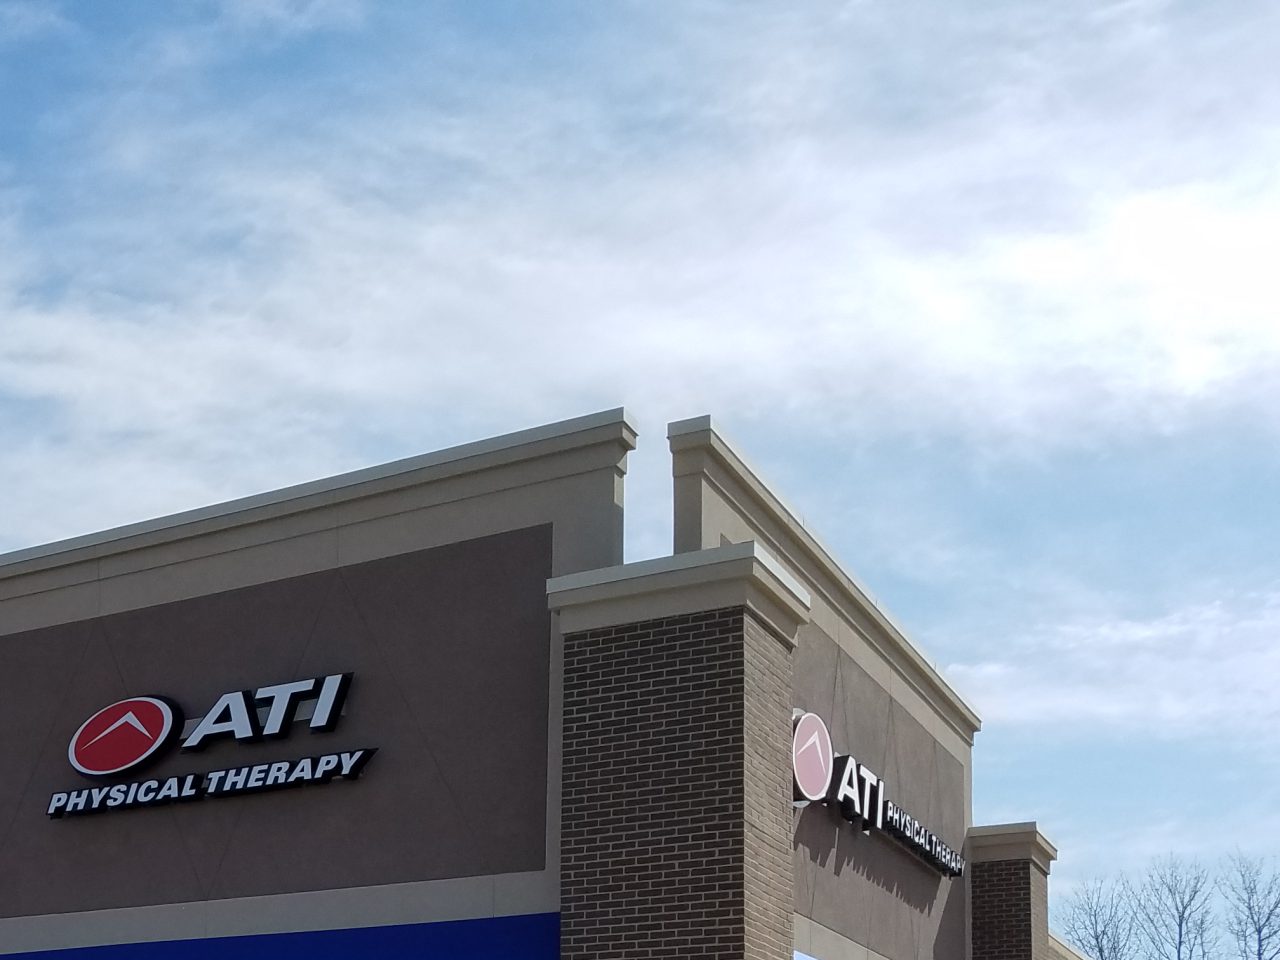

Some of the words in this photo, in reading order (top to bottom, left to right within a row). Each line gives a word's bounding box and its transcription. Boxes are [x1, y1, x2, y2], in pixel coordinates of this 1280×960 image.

[180, 673, 346, 749] ATI
[46, 774, 198, 816] PHYSICAL
[206, 750, 367, 794] THERAPY
[837, 756, 885, 829] ATI
[887, 801, 932, 851] PHYSICAL
[932, 834, 966, 875] THERAPY
